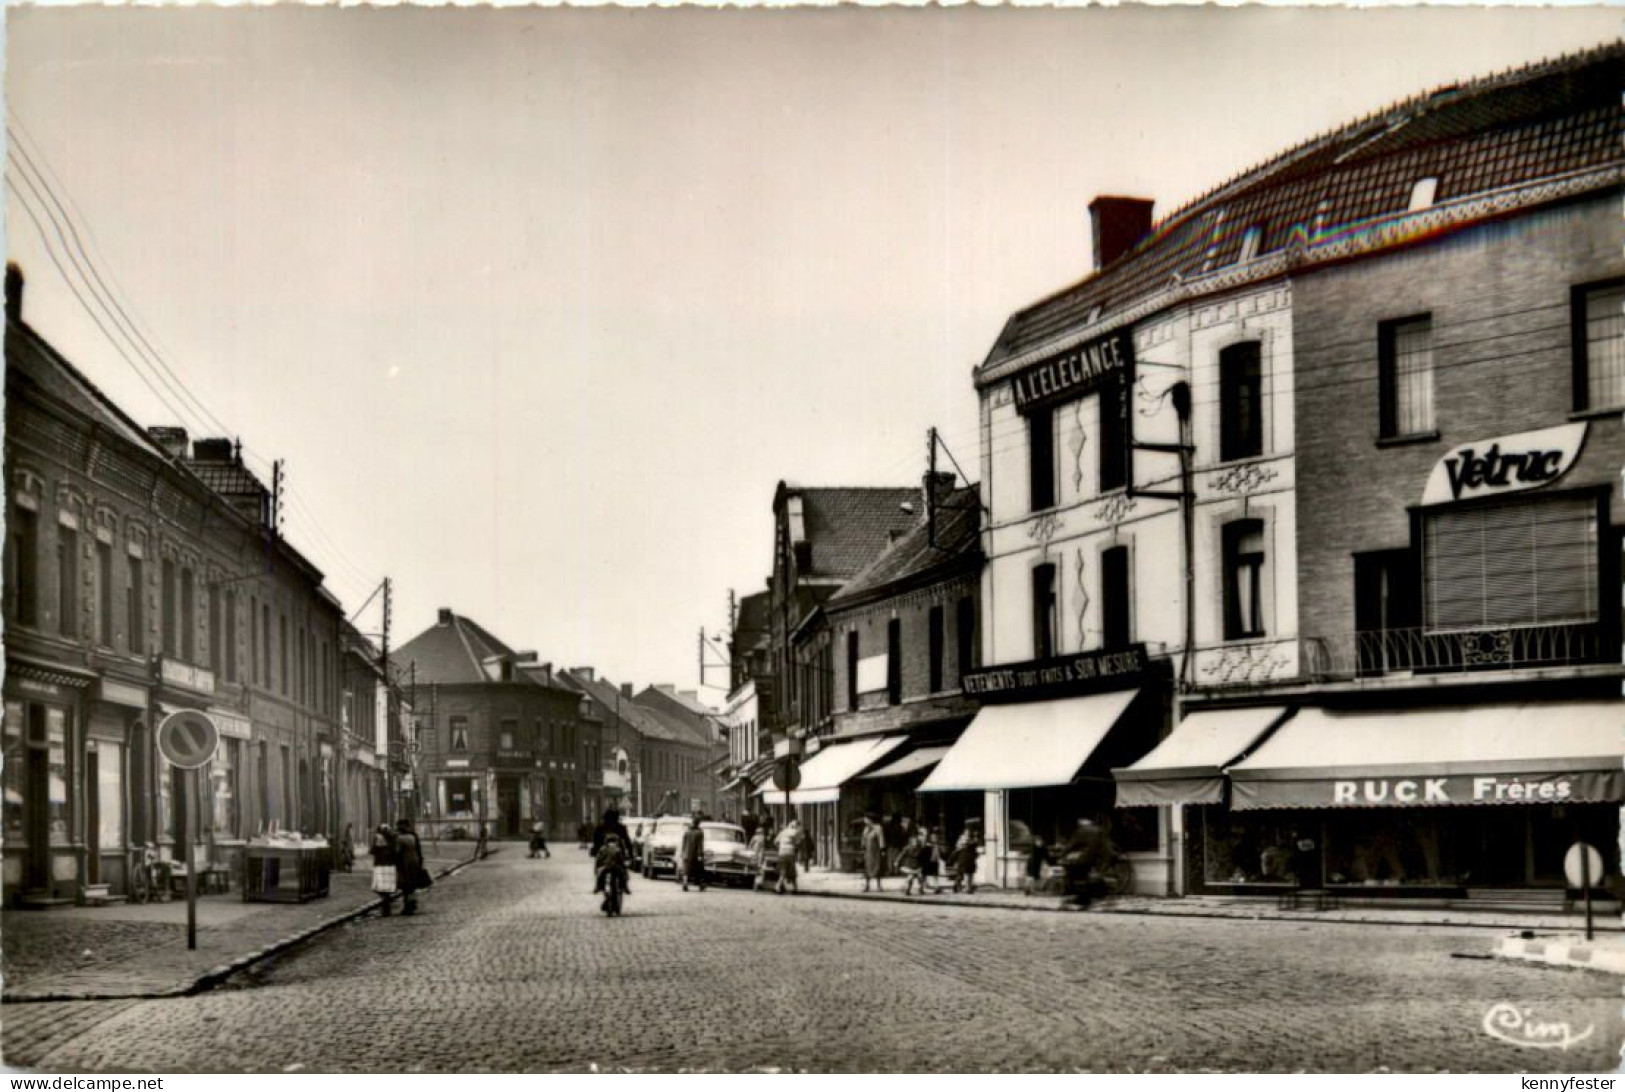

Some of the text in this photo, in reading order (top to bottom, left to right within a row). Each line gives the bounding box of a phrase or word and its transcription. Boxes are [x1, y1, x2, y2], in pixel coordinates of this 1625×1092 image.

[1444, 443, 1562, 500] Vetruc
[962, 669, 1015, 693] VETEMENTS
[1074, 657, 1096, 680] SUR
[1334, 777, 1571, 802] RUCK Frères
